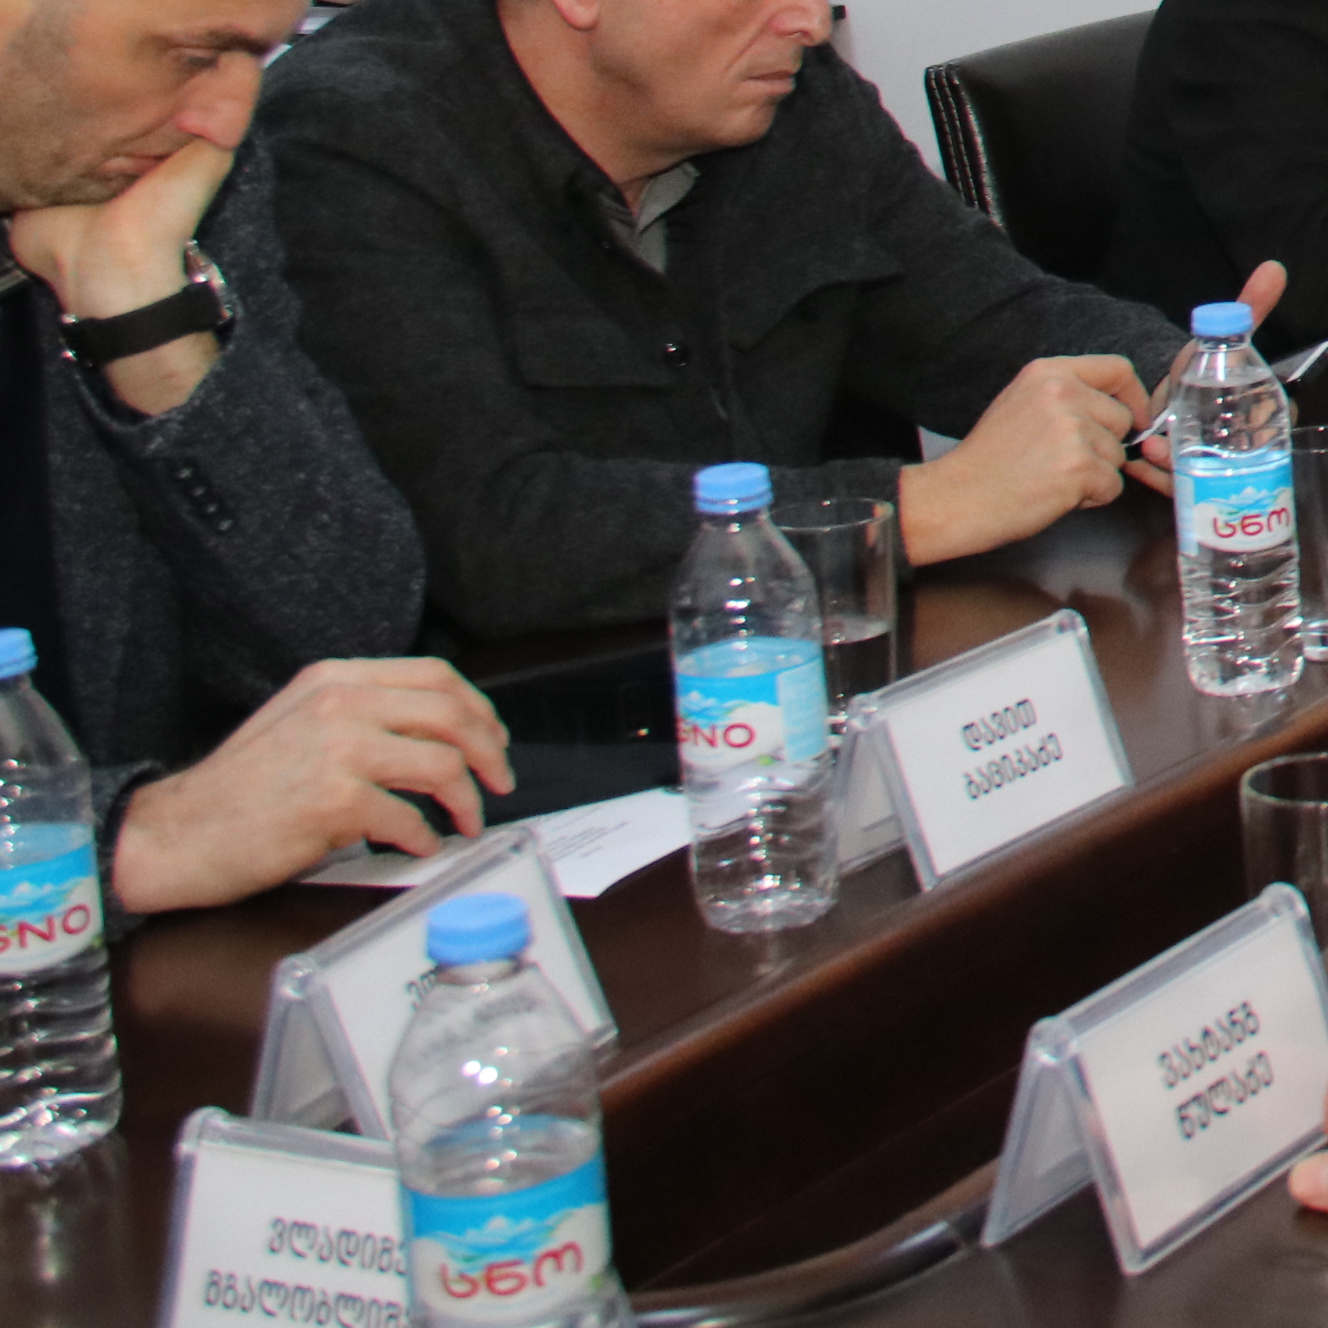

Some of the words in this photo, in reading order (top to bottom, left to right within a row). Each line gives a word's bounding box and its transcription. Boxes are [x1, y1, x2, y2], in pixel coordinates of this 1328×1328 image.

[1212, 506, 1291, 539] სნო
[961, 696, 1037, 752] დავით
[1157, 999, 1261, 1089] ვახტანგ
[440, 1240, 585, 1300] სნო
